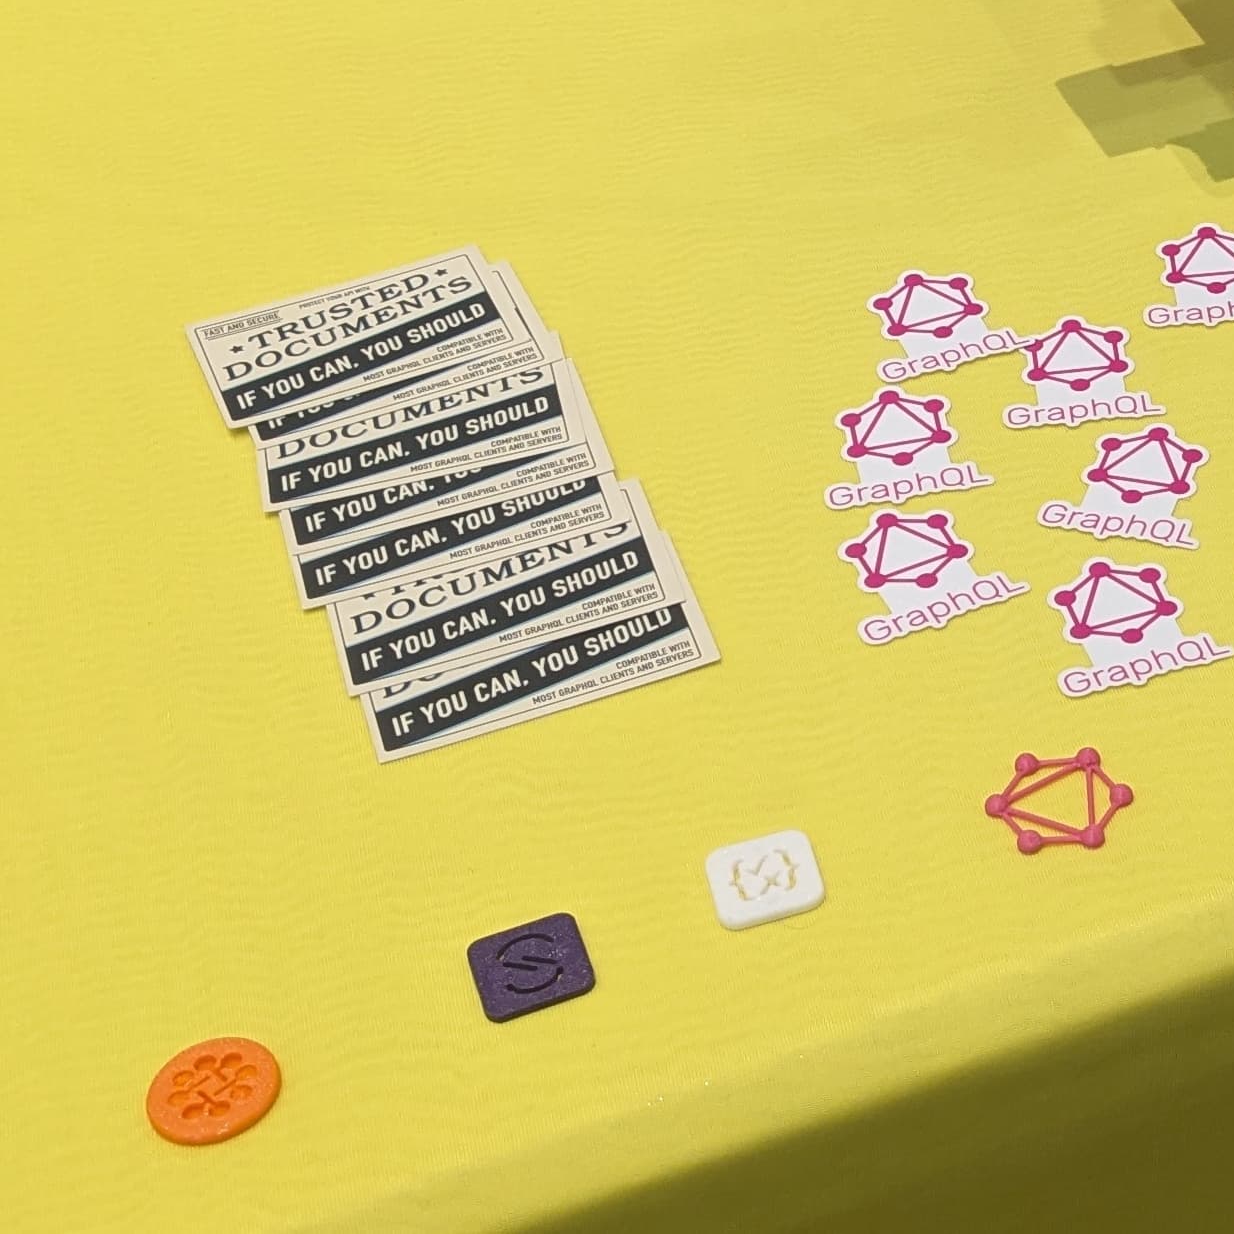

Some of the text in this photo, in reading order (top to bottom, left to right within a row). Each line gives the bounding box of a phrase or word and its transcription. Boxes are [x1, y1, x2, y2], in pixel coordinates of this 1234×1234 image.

[203, 311, 281, 339] FAST AND SECURE
[222, 276, 473, 382] DOCUMENTS
[248, 274, 429, 349] TRUSTED
[237, 389, 256, 410] IF
[260, 372, 305, 399] YOU
[360, 335, 403, 361] YOU
[407, 303, 486, 344] SHOULD
[363, 334, 507, 382] MOST GRAPHQL CLIENTS AND SERVERS
[436, 327, 503, 353] COMPATIBLE WITH
[467, 346, 535, 372] COMPATIBLE WITH
[882, 329, 1027, 380] GraphQL
[393, 352, 537, 401] MOST GRAPHQL CLIENTS AND SERVERS
[278, 368, 544, 459] DOCUMENTS
[1007, 395, 1161, 427] GraphQL
[281, 471, 301, 492] IF
[308, 456, 351, 483] YOU
[416, 424, 459, 451] YOU
[465, 396, 549, 435] SHOULD
[410, 433, 563, 473] MOST GRAPHQL CLIENTS AND SERVERS
[490, 425, 561, 448] COMPATIBLE WITH
[437, 495, 461, 507] MOST
[461, 485, 498, 501] GRAPHQL
[500, 475, 534, 490] CLIENTS
[535, 471, 552, 481] AND
[553, 459, 589, 476] SERVERS
[516, 452, 587, 477] COMPATIBLE WITH
[829, 465, 989, 507] GraphQL
[305, 511, 326, 533] IF
[331, 493, 377, 522] YOU
[450, 512, 605, 559] MOST GRAPHQL CLIENTS AND SERVERS
[530, 504, 602, 529] COMPATIBLE WITH
[1042, 503, 1196, 547] GraphQL
[315, 563, 337, 587] IF
[342, 545, 388, 575] YOU
[451, 507, 496, 535] YOU
[350, 523, 628, 636] DOCUMENTS
[582, 583, 656, 611] COMPATIBLE WITH
[360, 648, 382, 671] IF
[389, 628, 436, 660] YOU
[500, 586, 546, 617] YOU
[551, 550, 639, 598] SHOULD
[499, 591, 659, 643] MOST GRAPHQL CLIENTS AND SERVERS
[864, 575, 1025, 642] GraphQL
[532, 649, 694, 705] MOST GRAPHQL CLIENTS AND SERVERS
[616, 640, 691, 670] COMPATIBLE WITH
[1063, 640, 1229, 694] GraphQL
[391, 712, 415, 737] IF
[419, 691, 468, 724] YOU
[531, 645, 579, 678] YOU
